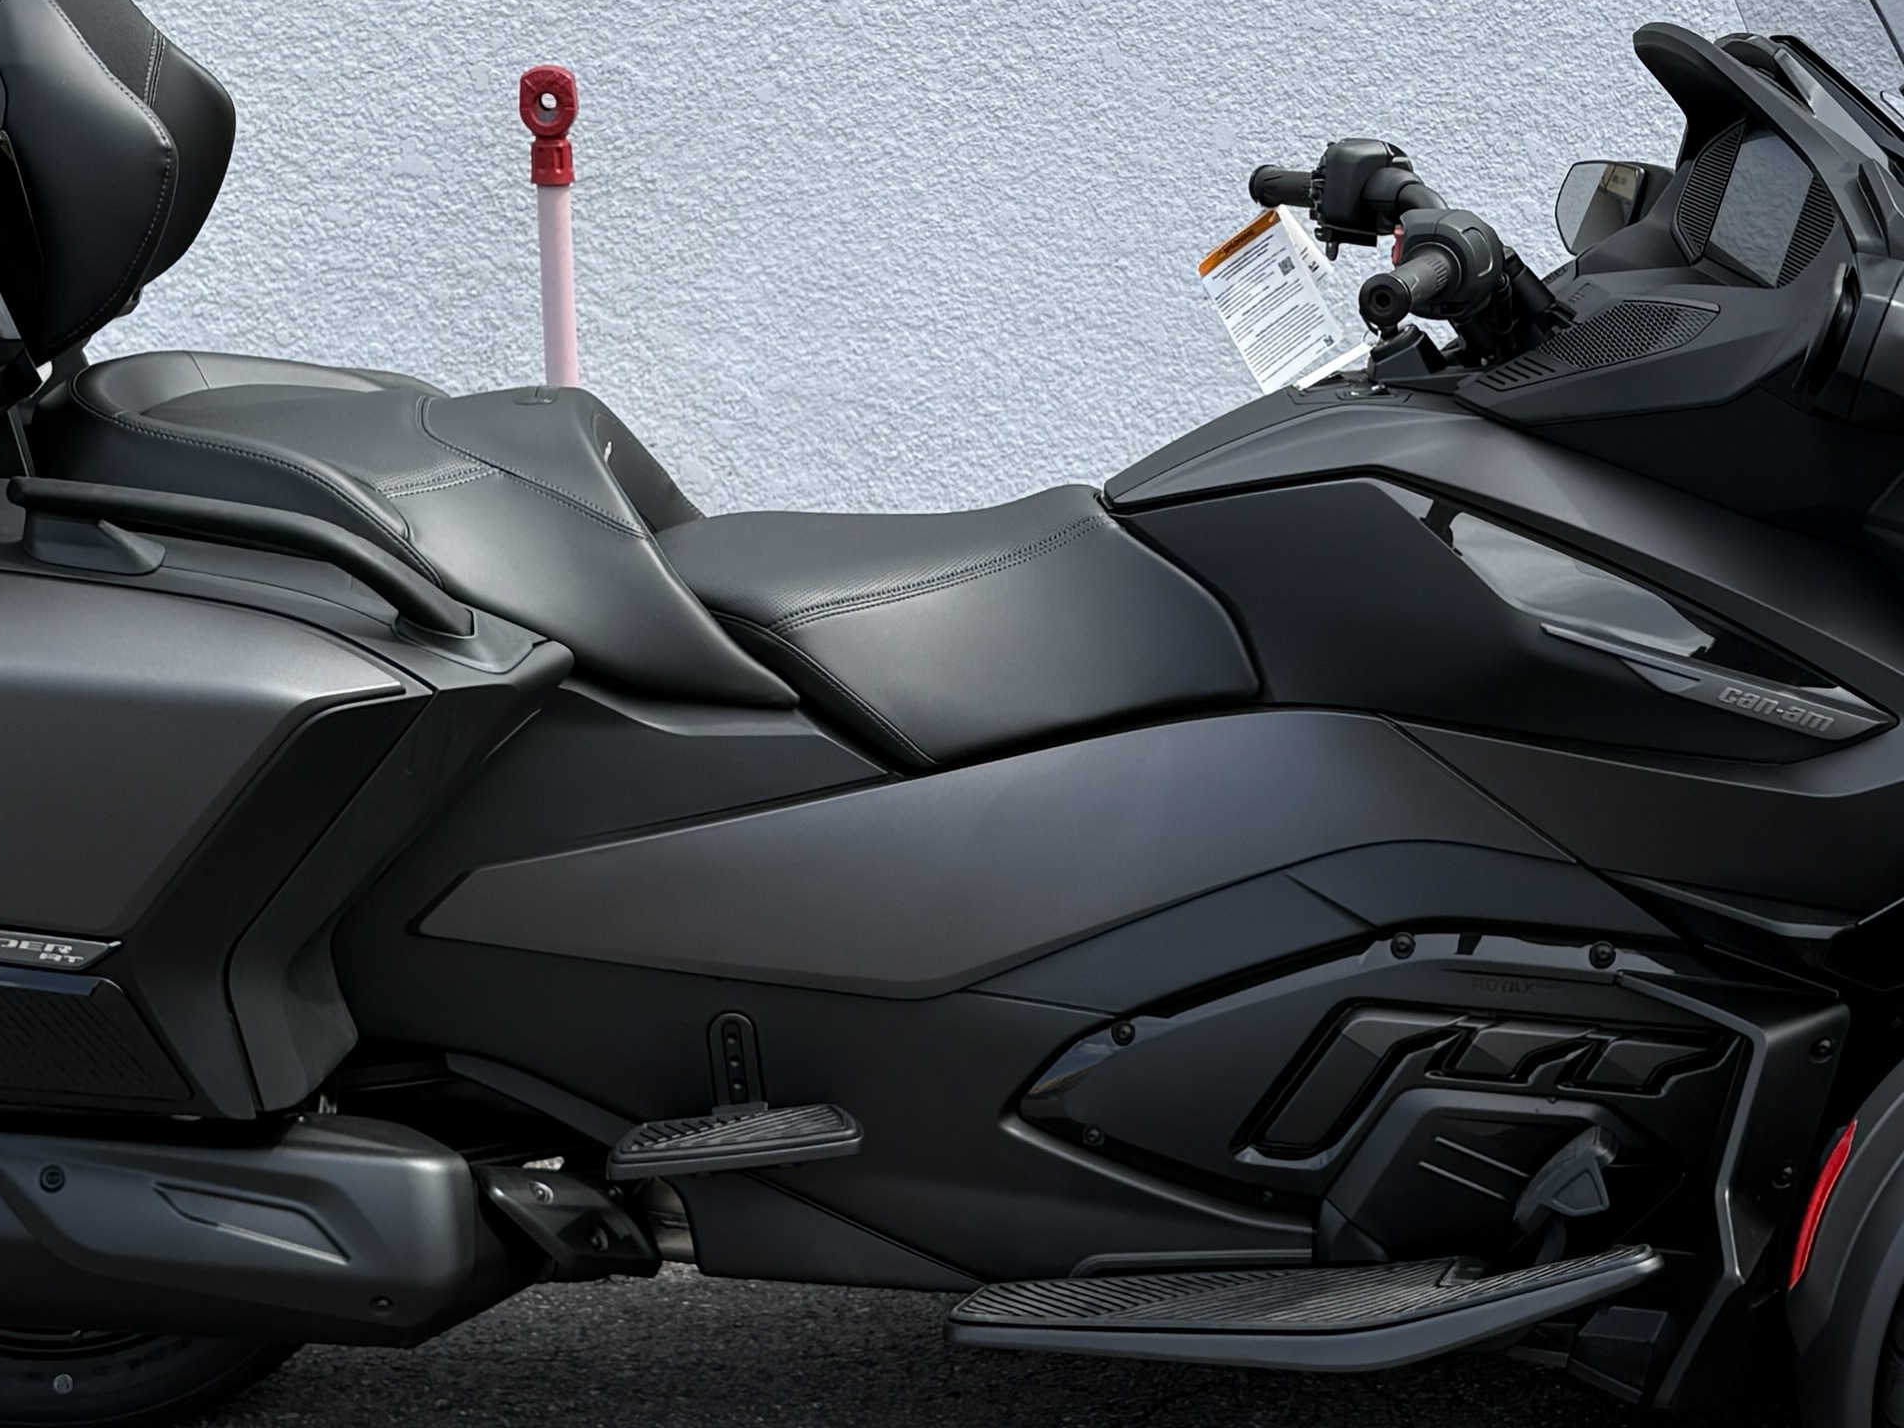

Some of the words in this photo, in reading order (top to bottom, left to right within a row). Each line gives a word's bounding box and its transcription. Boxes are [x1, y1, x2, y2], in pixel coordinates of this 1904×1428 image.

[1717, 685, 1836, 732] can-am
[38, 952, 85, 964] RT
[1470, 976, 1537, 995] ROTAX
